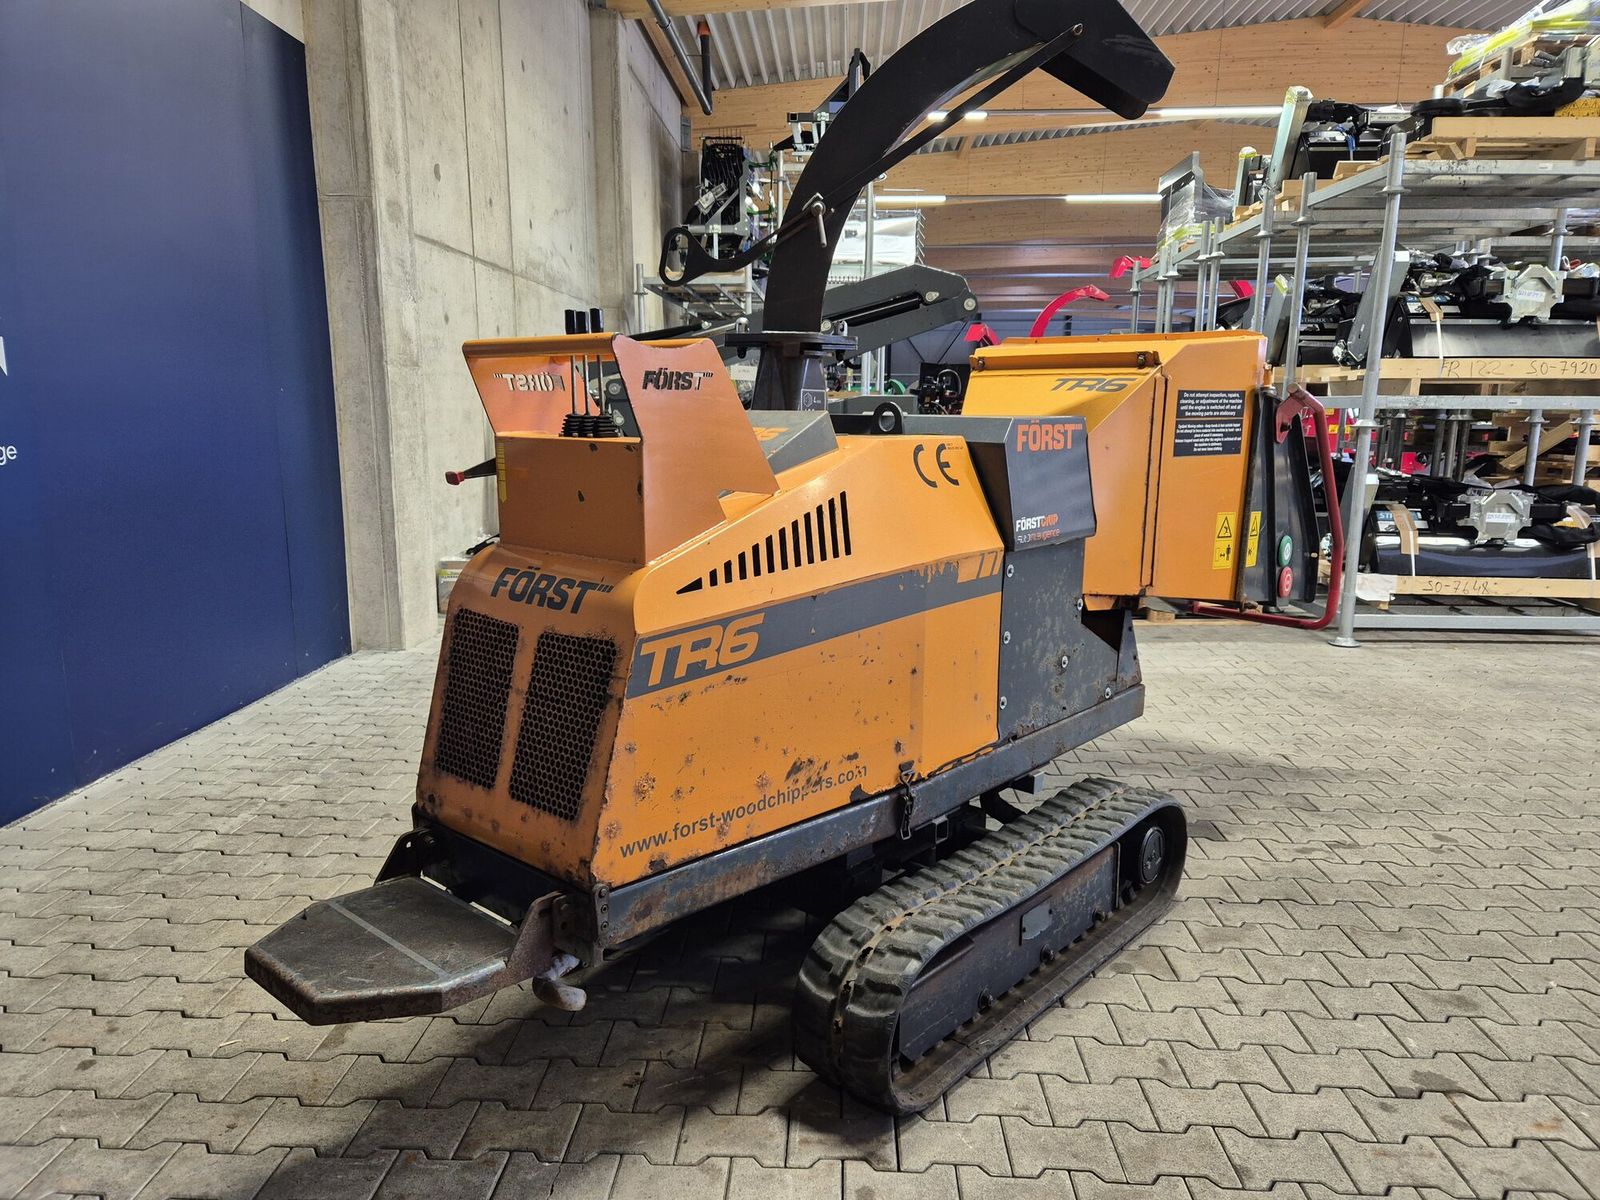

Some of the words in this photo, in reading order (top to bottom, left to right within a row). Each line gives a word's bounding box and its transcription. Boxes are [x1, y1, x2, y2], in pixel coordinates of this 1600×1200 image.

[642, 368, 713, 391] FÖRST
[1050, 377, 1138, 393] TR6
[1016, 419, 1083, 452] FÖRST
[489, 565, 613, 615] FÖRST
[640, 612, 766, 687] TR6
